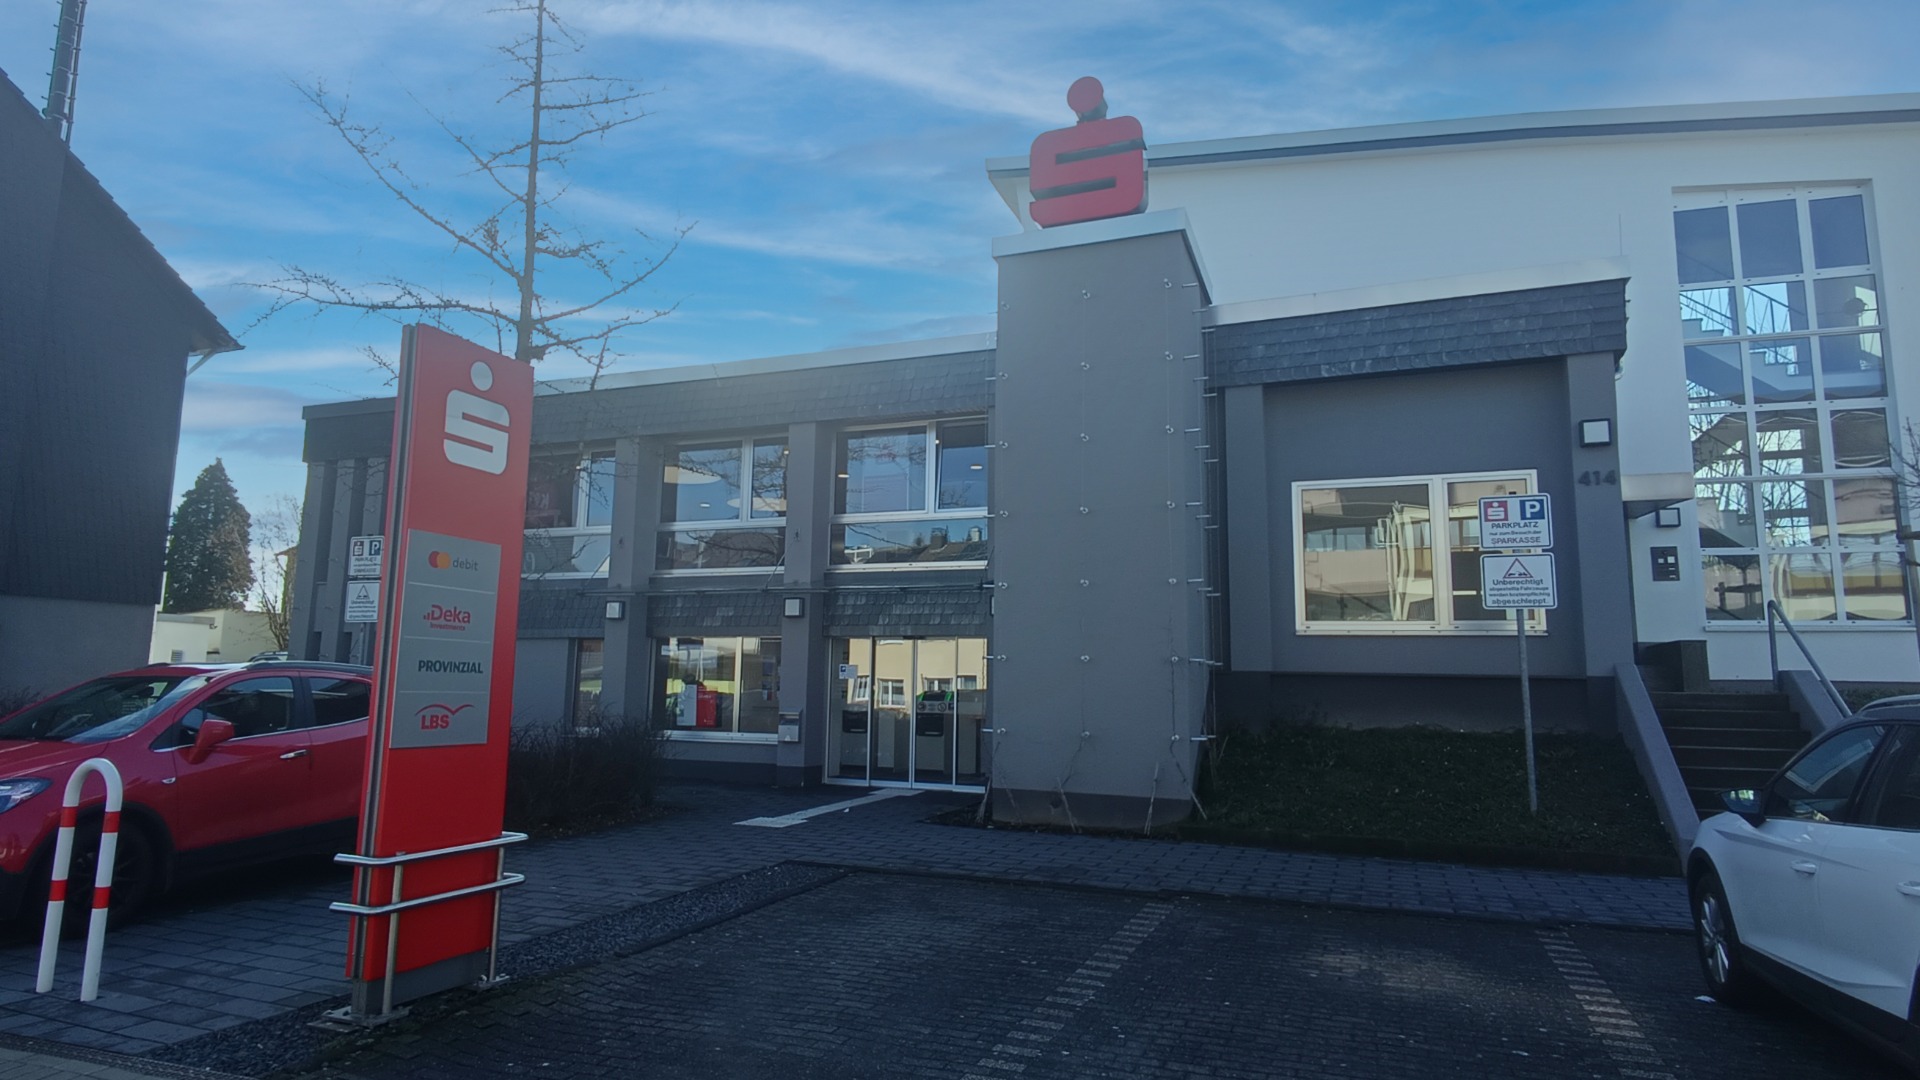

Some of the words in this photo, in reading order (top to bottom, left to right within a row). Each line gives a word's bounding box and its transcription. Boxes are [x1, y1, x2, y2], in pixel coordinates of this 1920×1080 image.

[1578, 470, 1617, 487] 414
[1525, 501, 1540, 518] P
[1491, 537, 1541, 545] SPARKASSE
[452, 557, 479, 572] debit
[431, 604, 471, 624] Deka
[430, 622, 466, 631] Investments
[418, 660, 483, 674] PROVINZIAL
[421, 714, 450, 730] LBS
